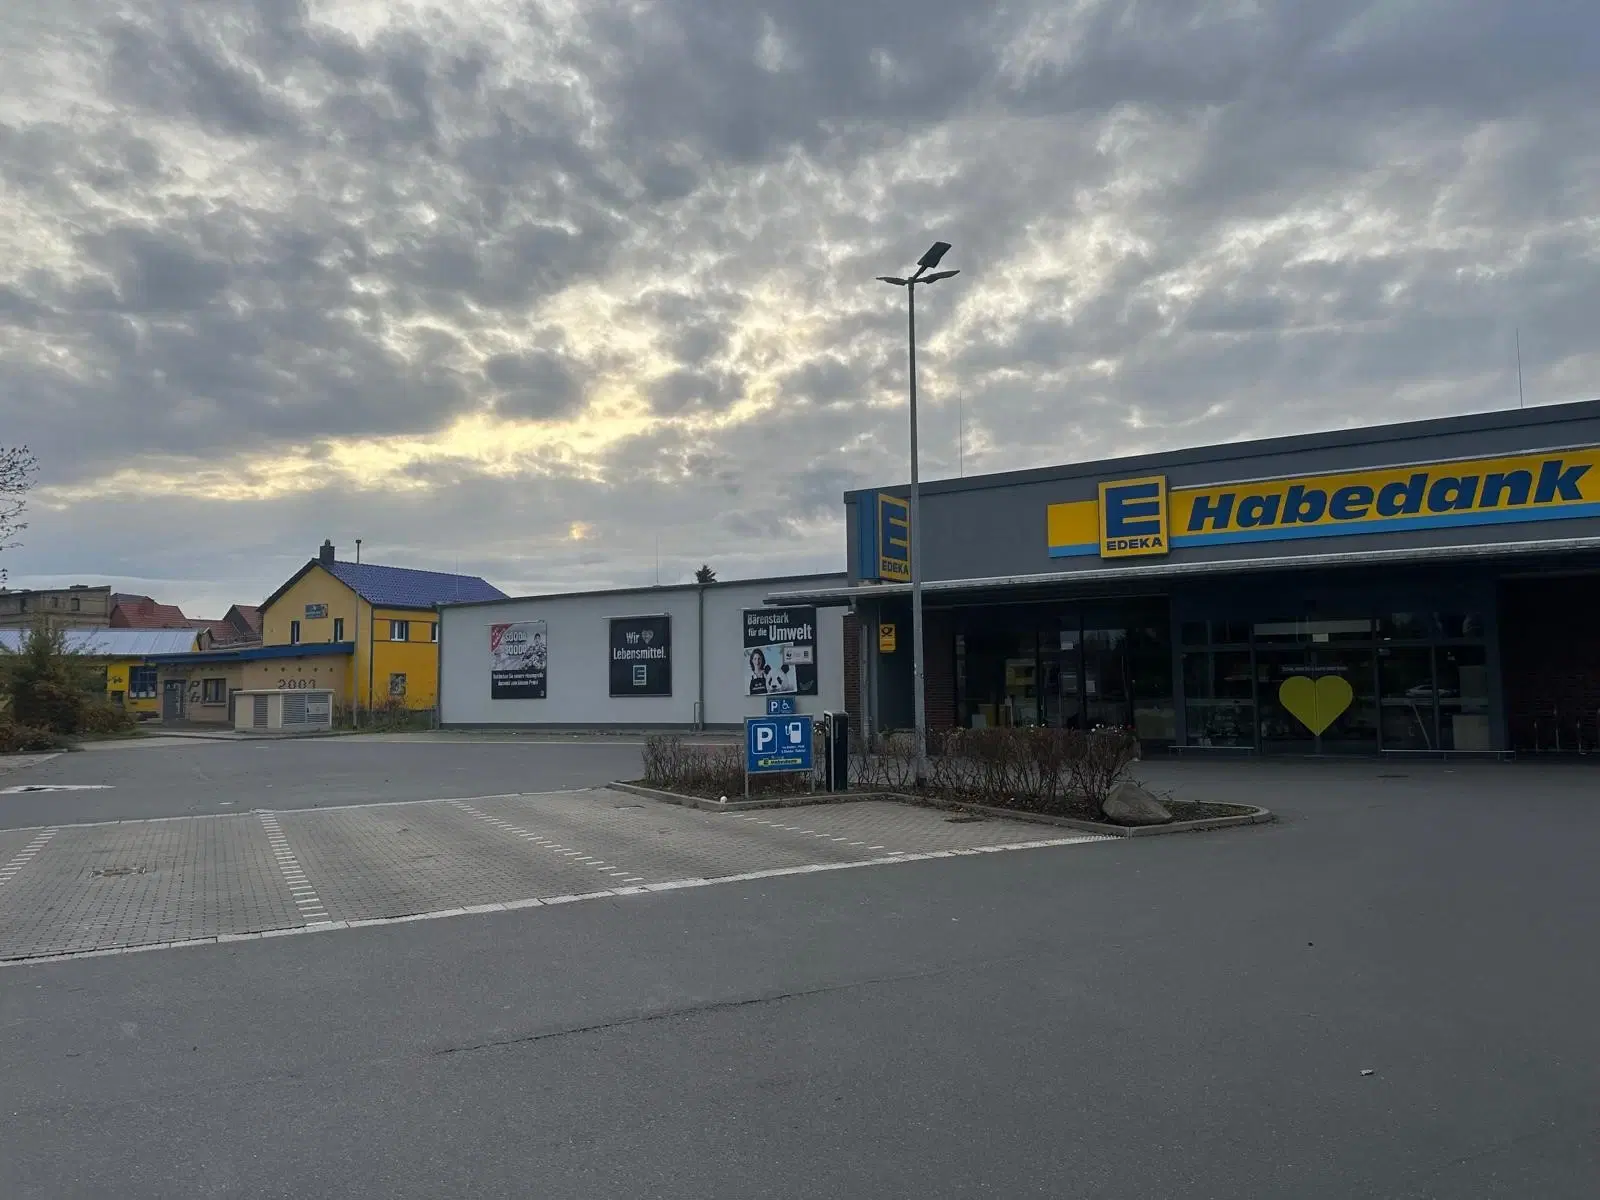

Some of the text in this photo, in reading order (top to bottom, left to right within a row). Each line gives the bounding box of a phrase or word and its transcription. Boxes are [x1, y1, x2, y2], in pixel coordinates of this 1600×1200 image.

[1187, 460, 1593, 531] Habedank
[1105, 483, 1160, 538] E
[1107, 537, 1163, 551] EDEKA
[881, 560, 909, 575] EDEKA
[747, 612, 789, 625] Bärenstark
[626, 632, 640, 644] Wir
[748, 624, 813, 641] für die Umwelt
[613, 646, 667, 660] Lebensmittel.
[771, 701, 778, 712] P
[757, 727, 773, 751] P
